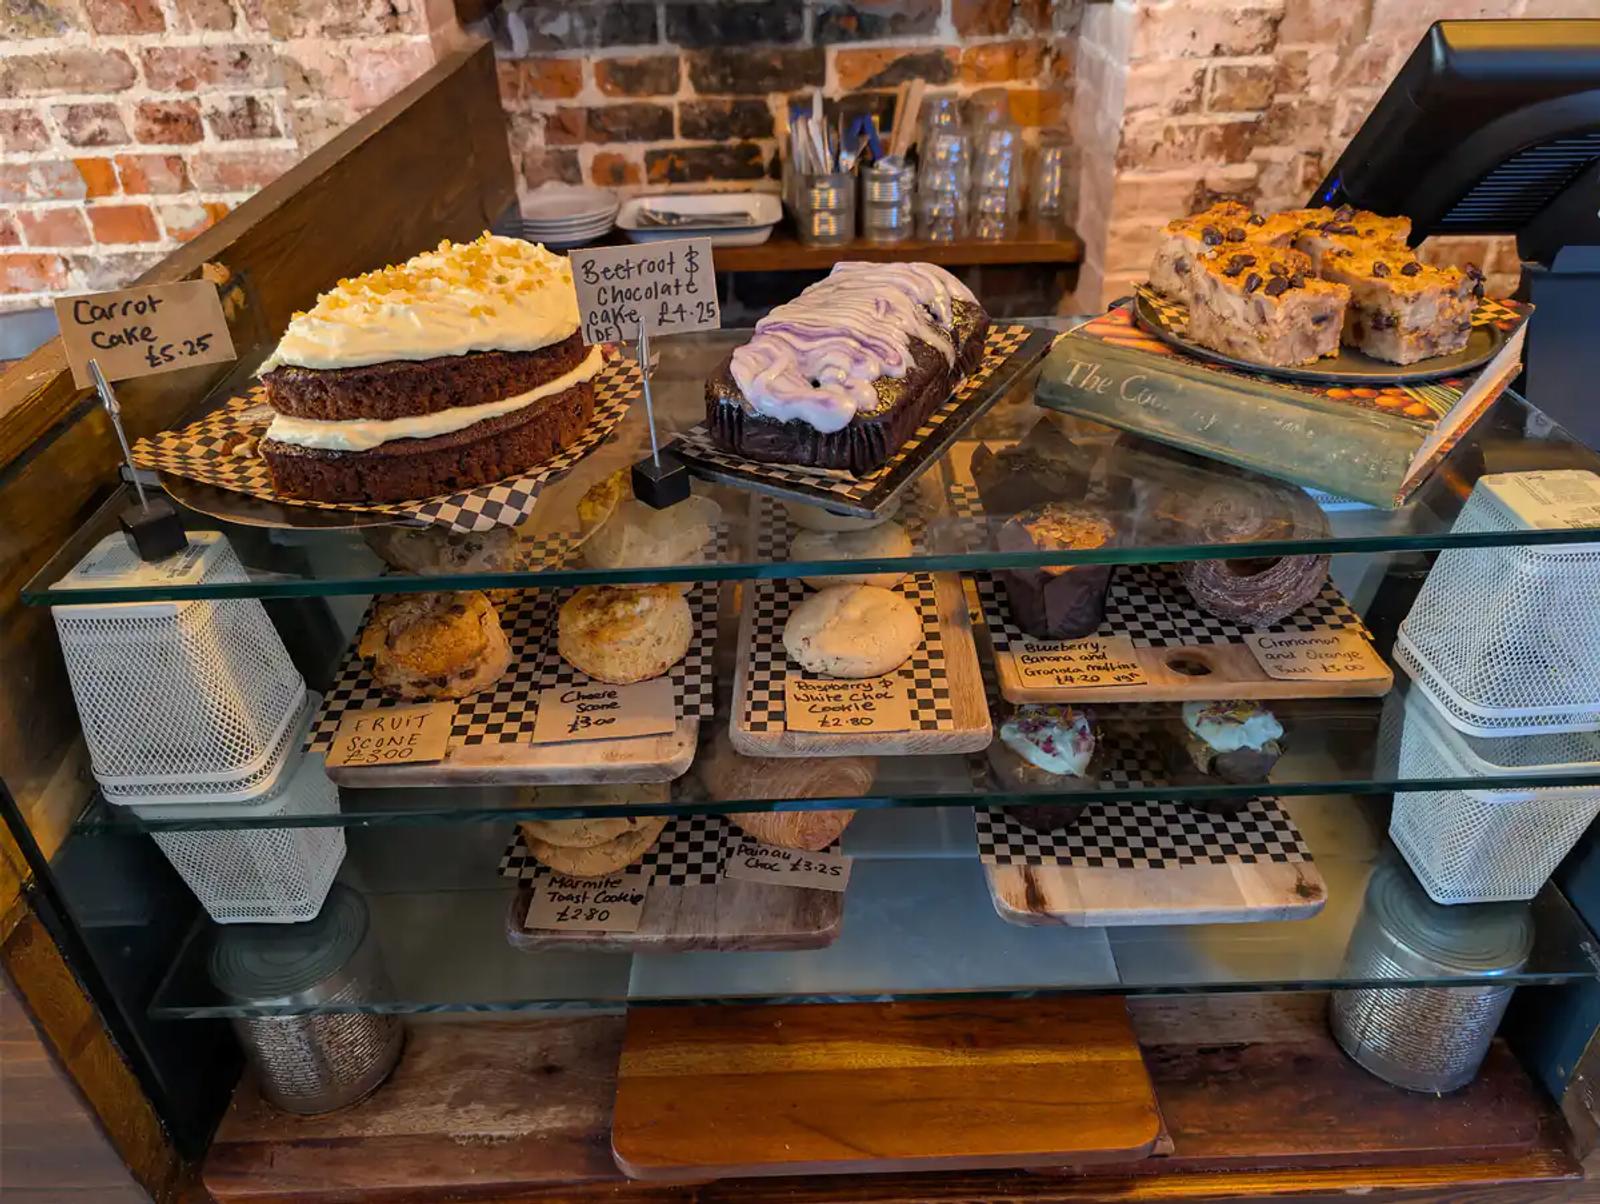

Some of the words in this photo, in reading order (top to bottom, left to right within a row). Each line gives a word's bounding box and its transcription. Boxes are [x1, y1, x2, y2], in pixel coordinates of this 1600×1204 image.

[581, 251, 676, 285] Beetroot
[597, 278, 699, 306] Chocolate
[73, 294, 163, 325] Carrot
[658, 301, 716, 326] £4.25
[586, 323, 623, 343] (DF)
[145, 333, 213, 368] £5.25
[1063, 358, 1114, 394] The
[1258, 636, 1341, 649] Cinnamon
[1020, 654, 1076, 665] Banana
[1079, 652, 1108, 661] and
[1265, 650, 1297, 660] and
[1305, 649, 1363, 661] Orange
[1024, 667, 1085, 677] Granola
[794, 680, 873, 692] Raspberry
[1055, 674, 1101, 685] £4.20
[793, 693, 843, 702] White
[808, 701, 876, 714] Cookie
[818, 714, 874, 728] £2.80
[346, 733, 422, 752] SCONE
[790, 857, 843, 876] £3.25
[548, 876, 623, 889] Marmite
[546, 890, 590, 904] Toast
[556, 905, 610, 921] £2.80
